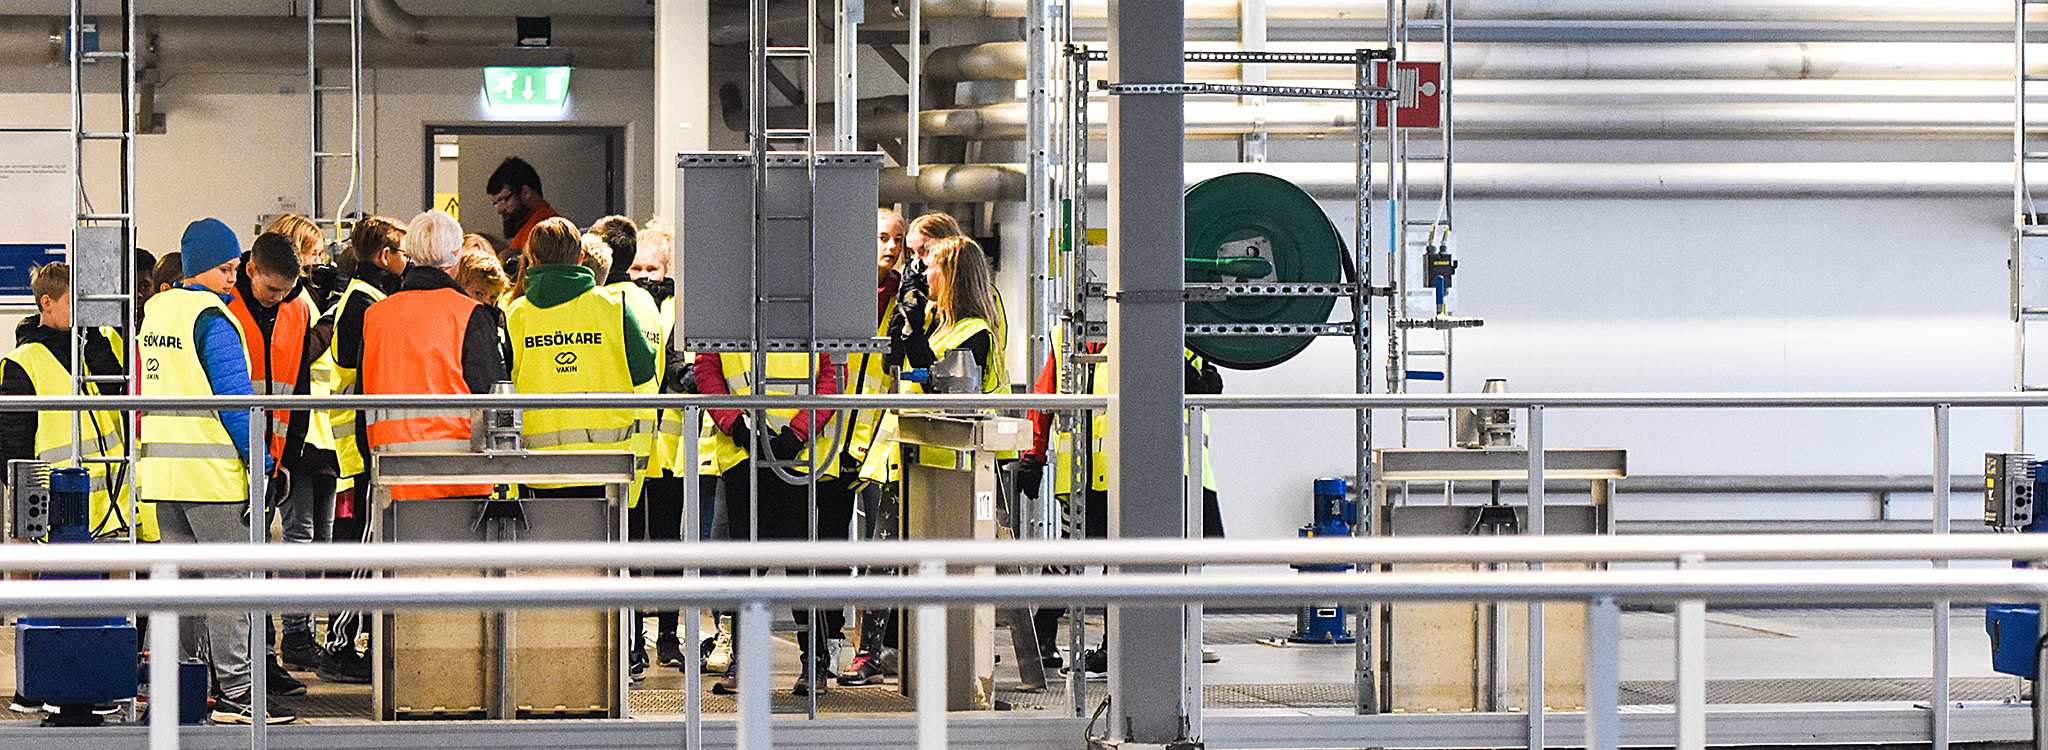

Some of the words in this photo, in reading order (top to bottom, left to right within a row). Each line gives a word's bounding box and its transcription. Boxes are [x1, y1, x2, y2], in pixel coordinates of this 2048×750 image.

[524, 330, 602, 348] BESÖKARE
[641, 329, 660, 345] KARE
[555, 365, 578, 374] VAKIN
